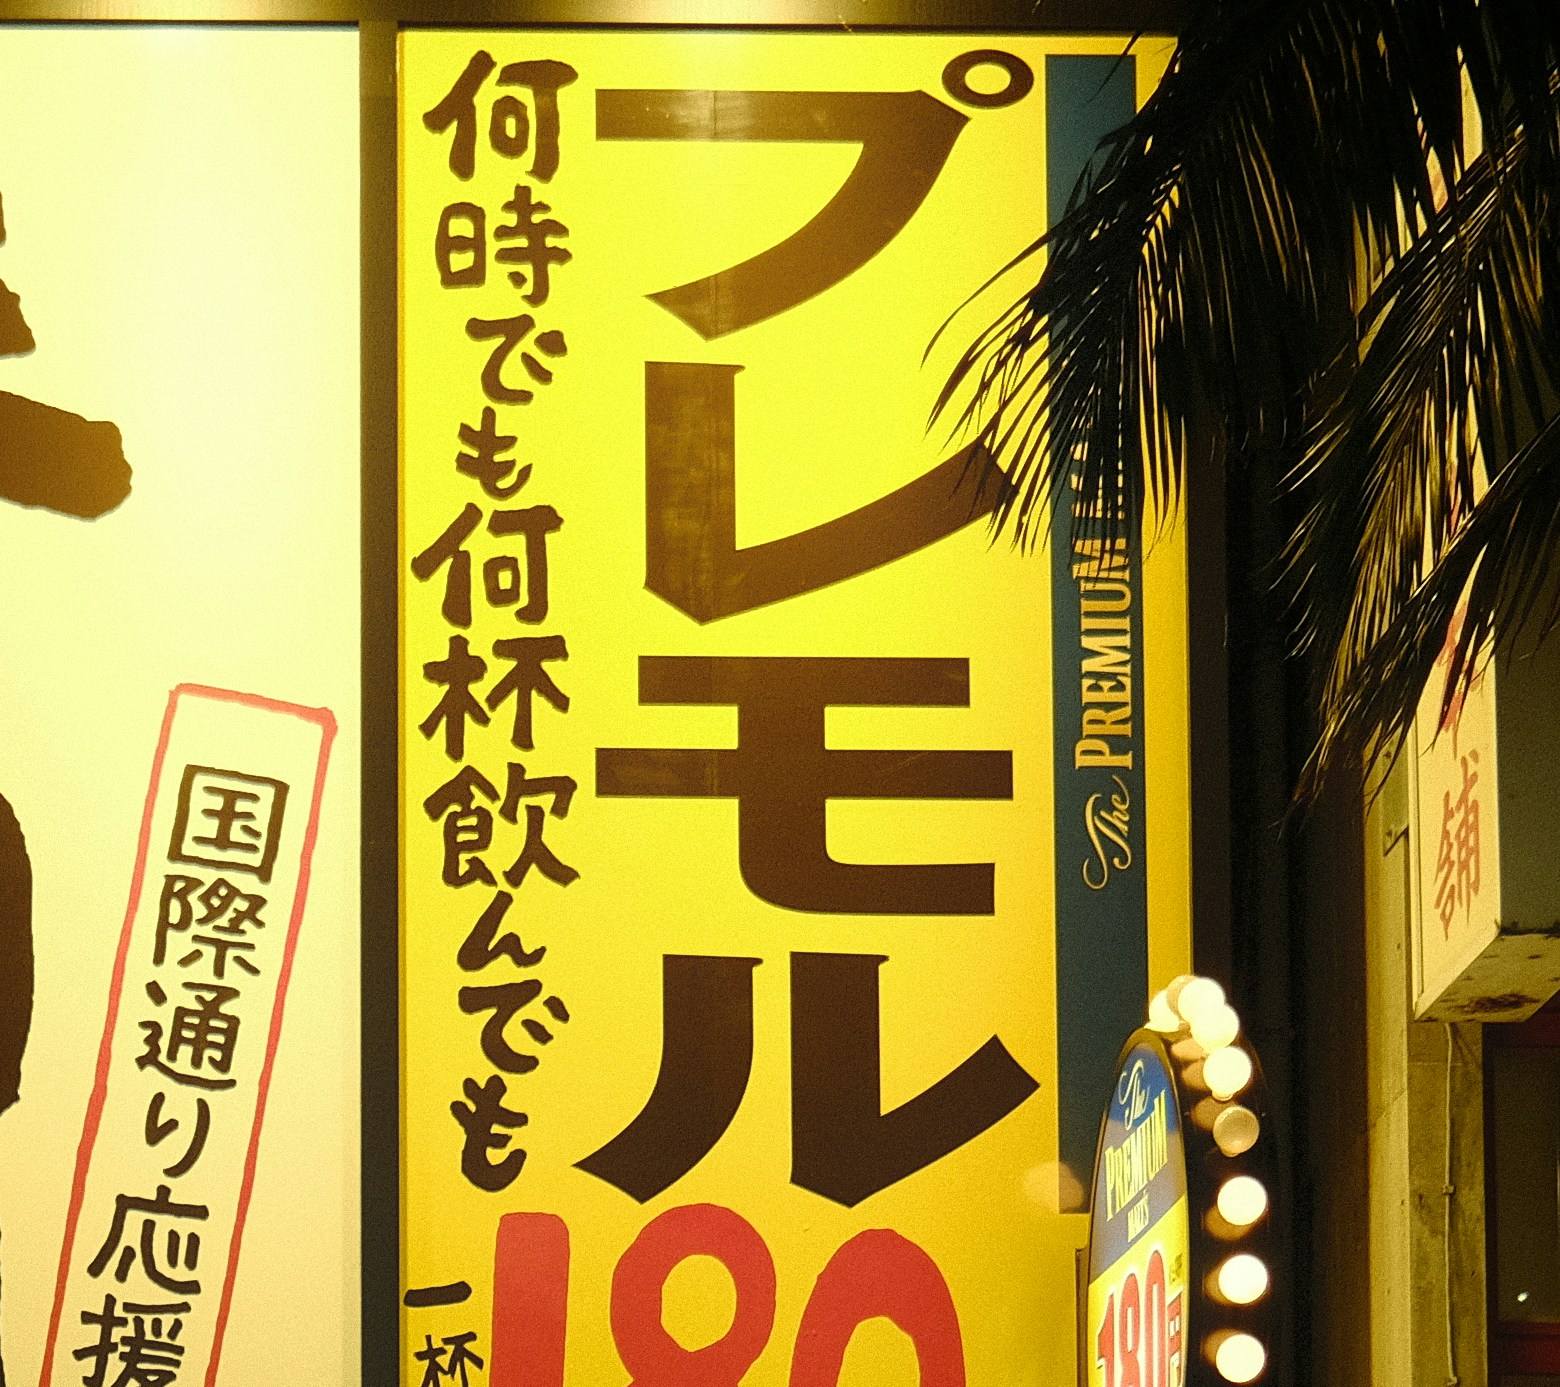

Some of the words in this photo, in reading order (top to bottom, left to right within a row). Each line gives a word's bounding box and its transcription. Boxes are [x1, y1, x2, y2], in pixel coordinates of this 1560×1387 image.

[411, 50, 580, 1192] 何時でも何杯飲んでも
[573, 49, 1040, 1207] プレモル
[1105, 1089, 1169, 1222] PREMIUM
